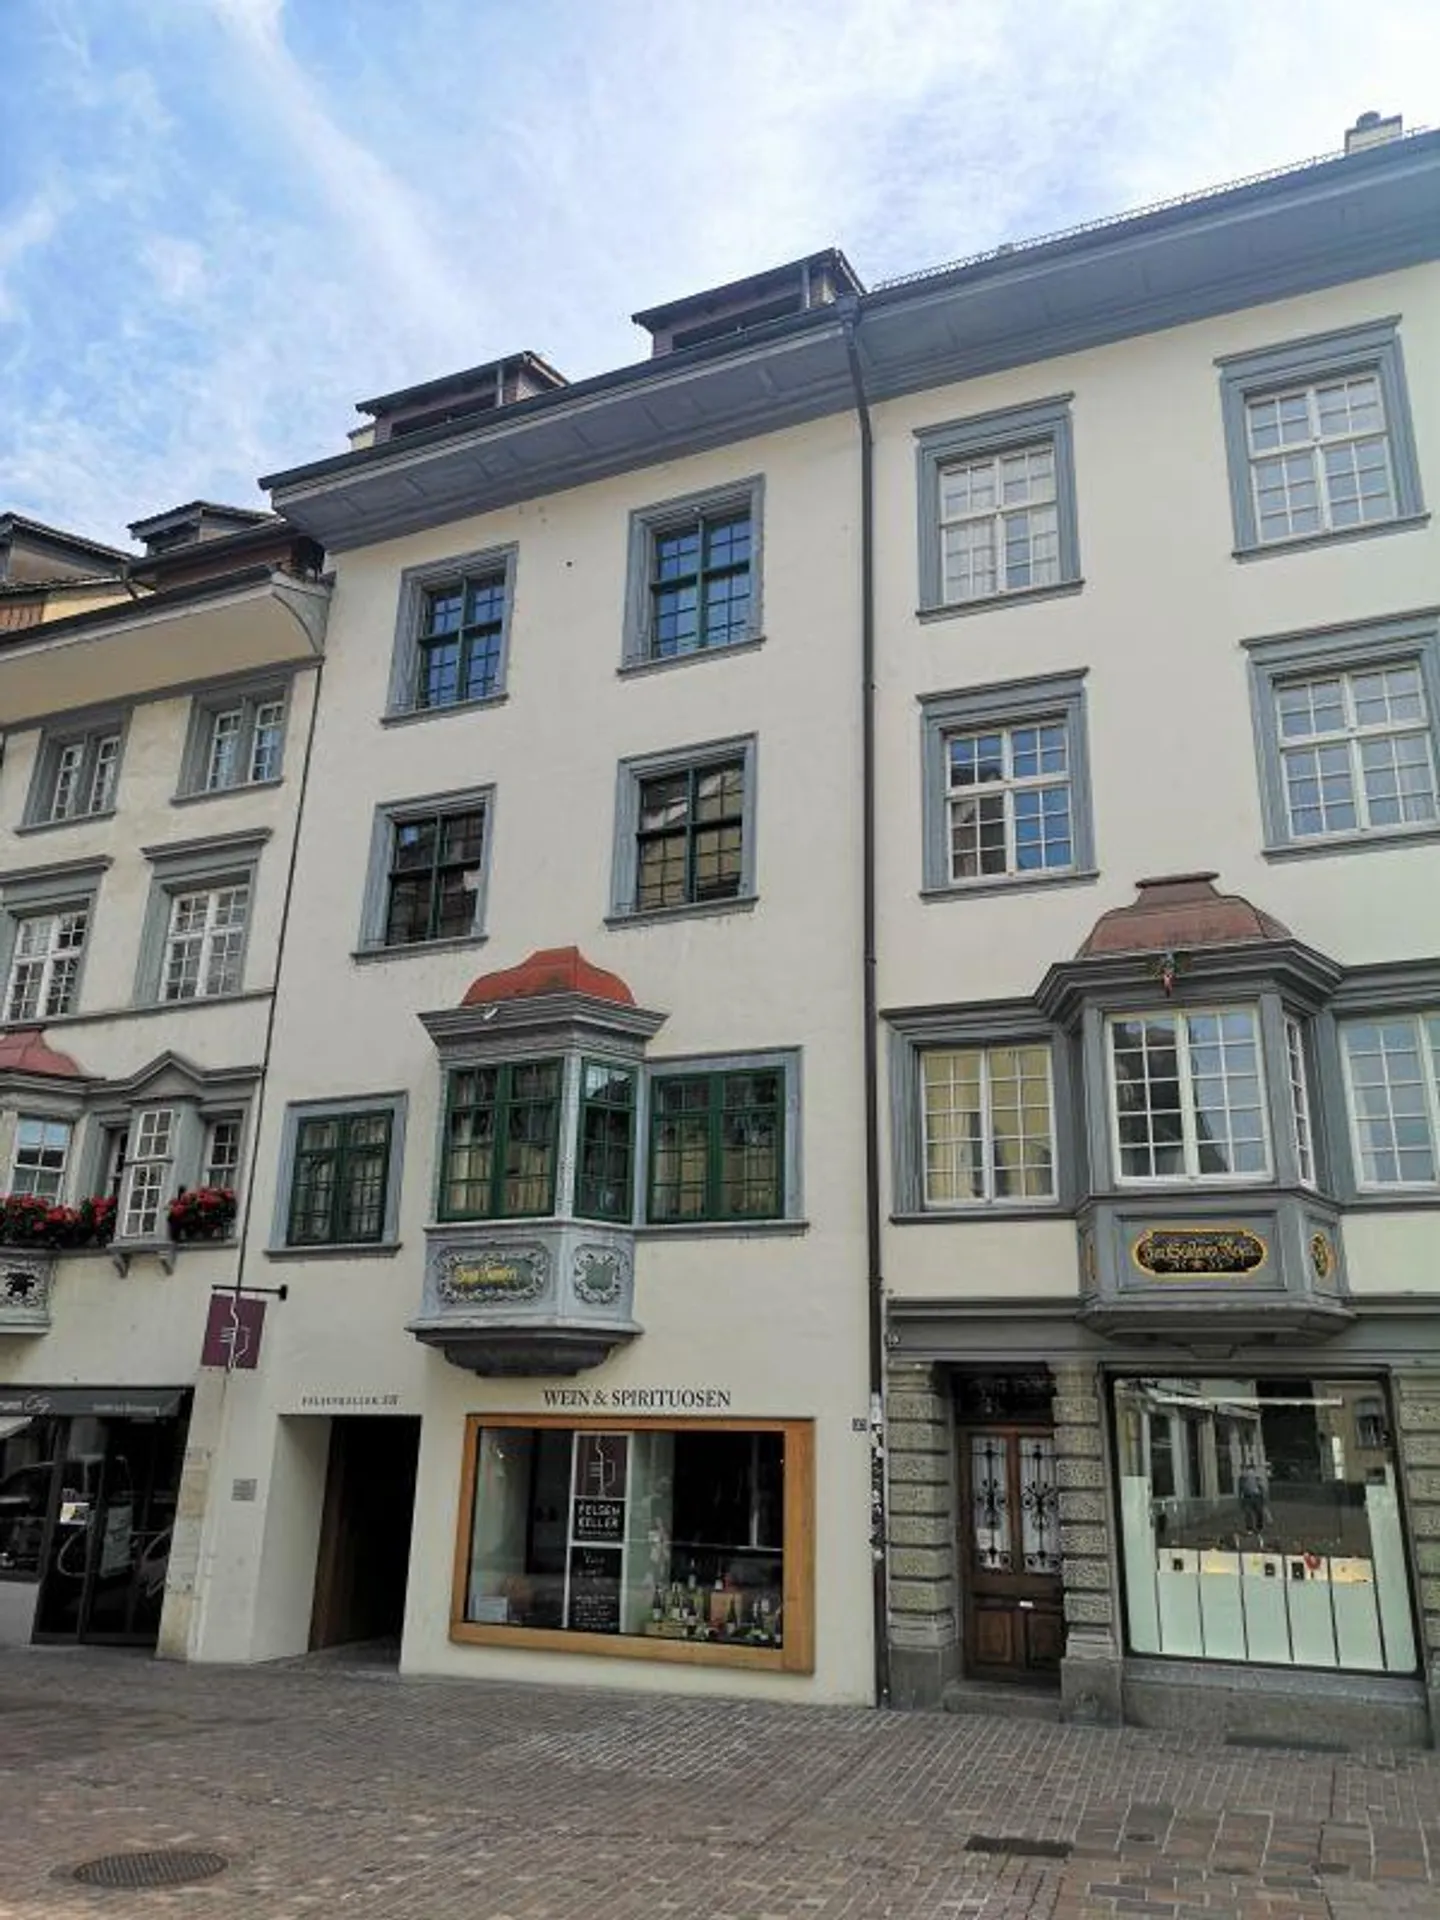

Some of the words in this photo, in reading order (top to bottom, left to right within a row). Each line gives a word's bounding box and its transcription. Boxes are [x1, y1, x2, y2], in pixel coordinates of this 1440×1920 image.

[544, 1389, 590, 1405] WEIN
[593, 1390, 607, 1405] &
[611, 1389, 731, 1408] SPIRITUOSEN
